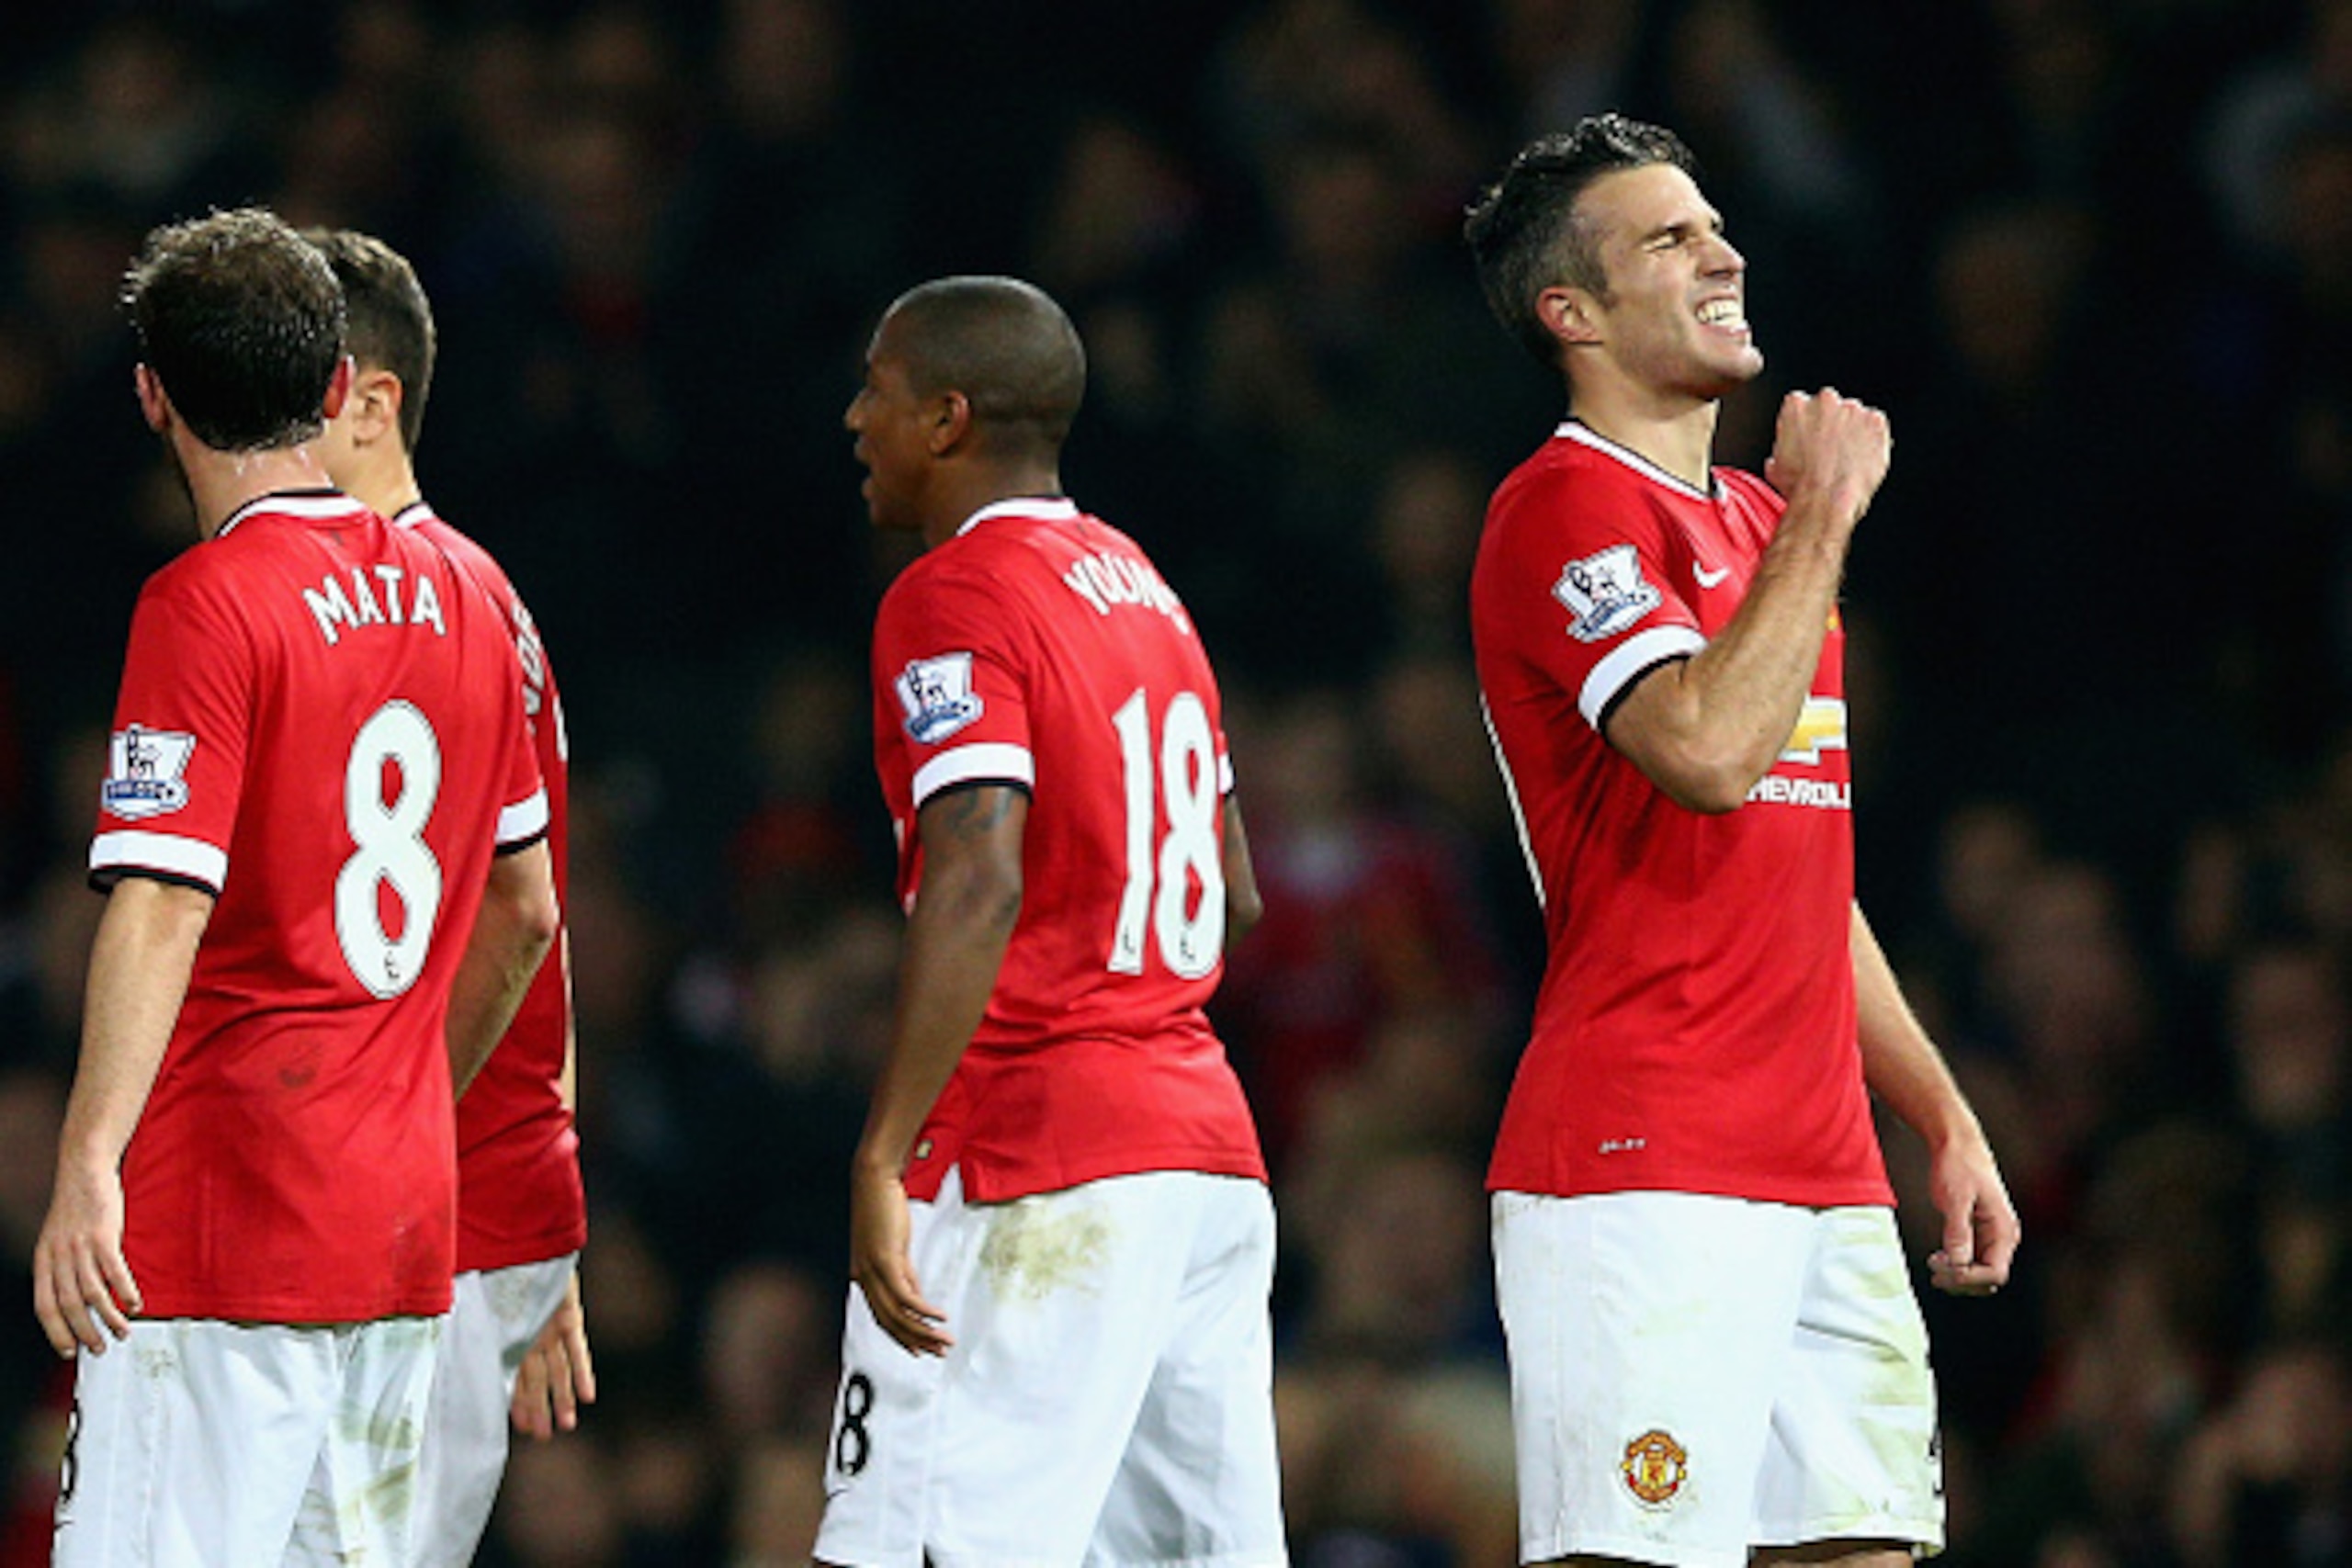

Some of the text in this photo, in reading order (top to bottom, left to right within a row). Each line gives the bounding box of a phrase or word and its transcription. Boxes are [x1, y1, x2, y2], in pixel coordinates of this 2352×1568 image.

[302, 564, 447, 645] MATA
[1109, 687, 1225, 979] 18
[1746, 775, 1851, 809] HEVROL
[334, 698, 443, 1000] 8
[835, 1373, 874, 1477] 8
